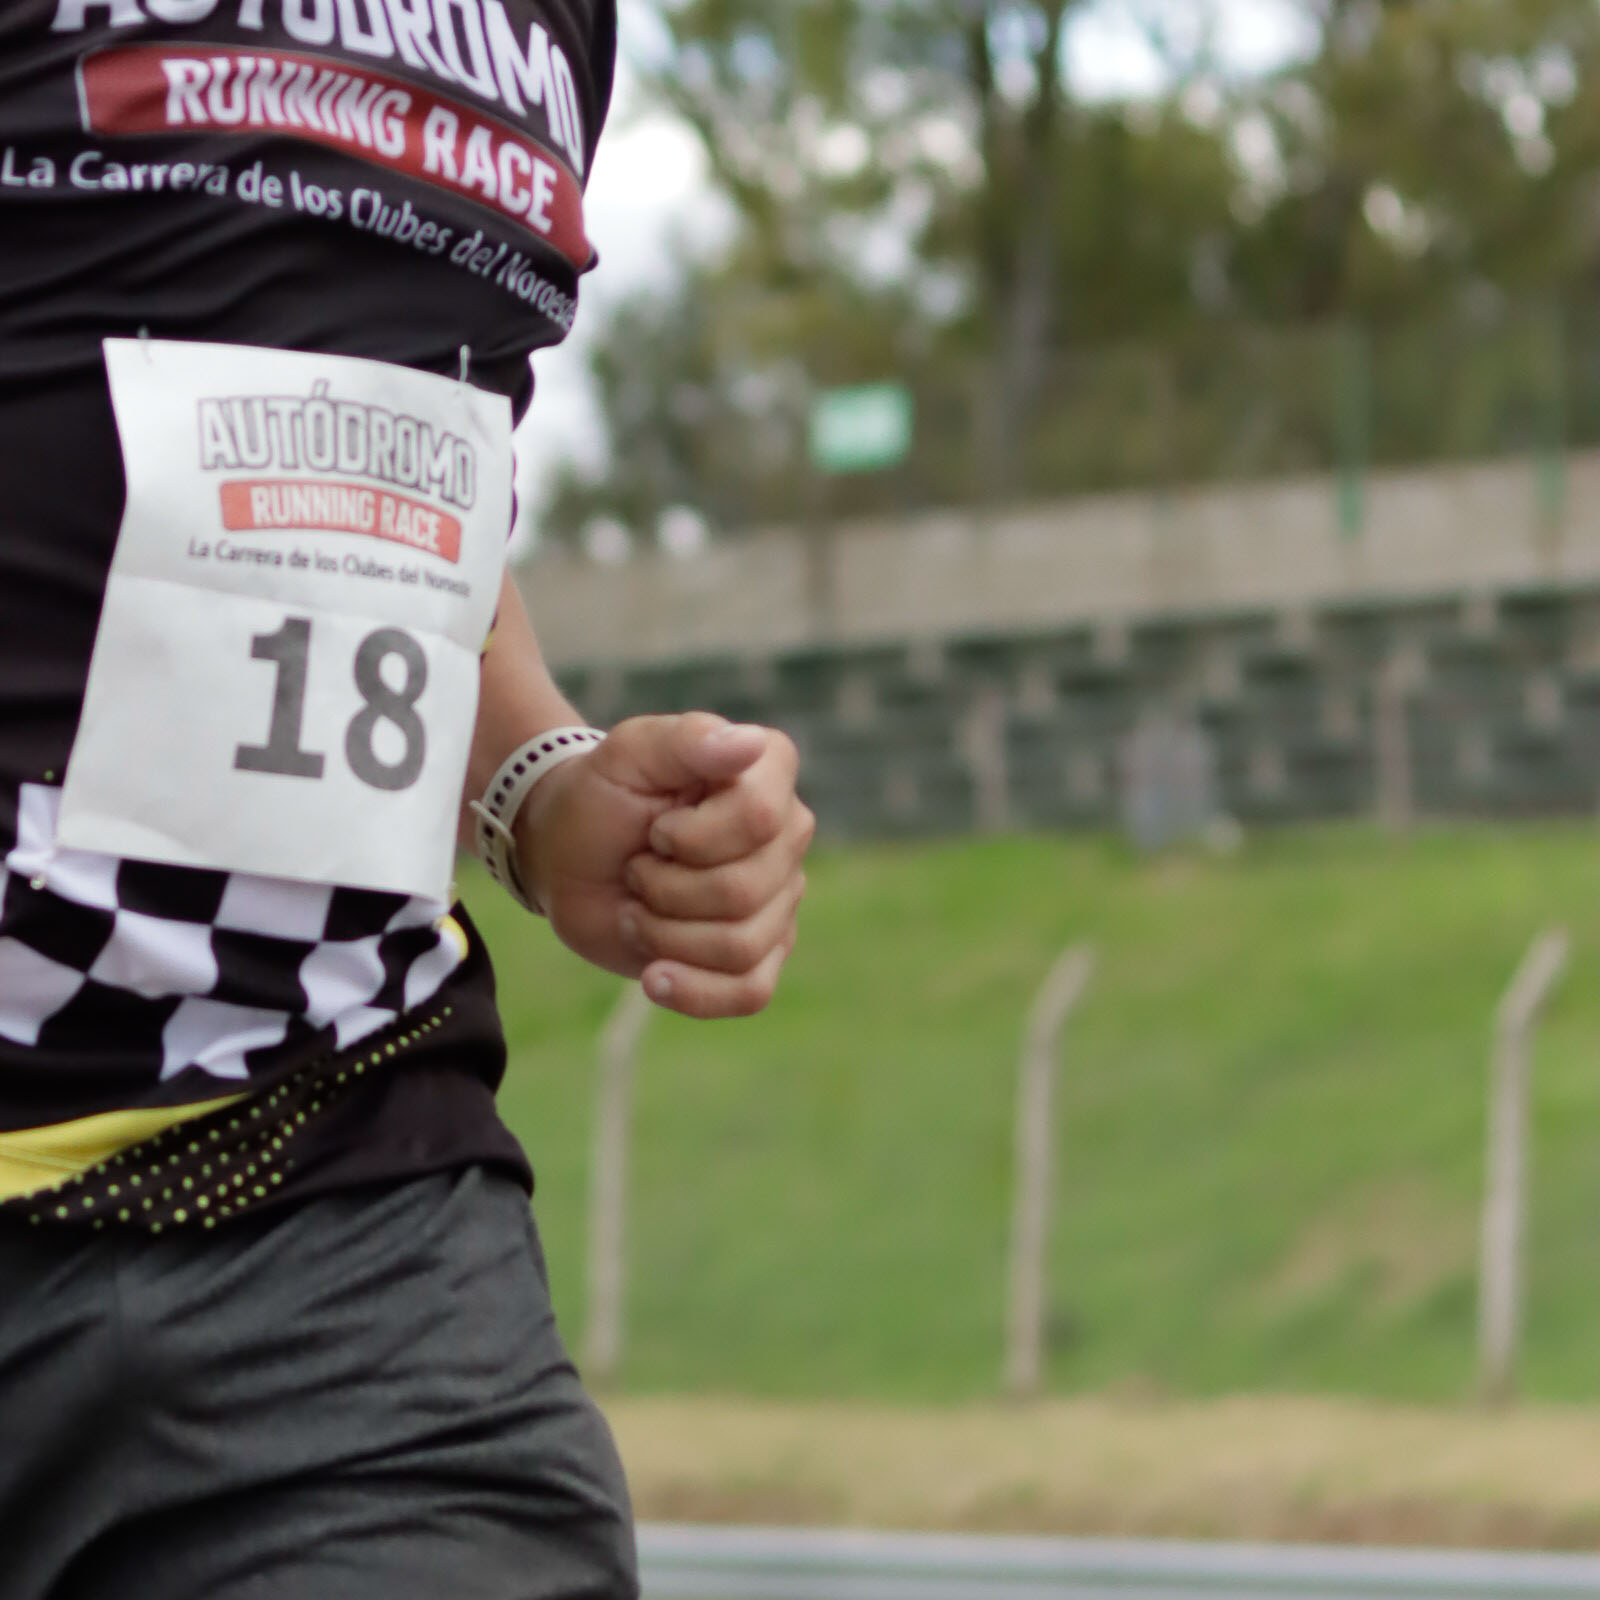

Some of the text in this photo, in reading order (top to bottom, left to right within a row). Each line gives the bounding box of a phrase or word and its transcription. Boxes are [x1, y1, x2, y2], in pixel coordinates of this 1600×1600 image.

[161, 56, 558, 235] RUNNING RACE
[1, 147, 55, 188] La
[69, 150, 229, 196] Carrera
[236, 160, 284, 208] de
[290, 169, 344, 219] los
[350, 187, 453, 255] Clubes
[450, 229, 508, 277] del
[197, 379, 476, 512] AUTÓDROMO
[188, 536, 210, 559] La
[215, 539, 283, 568] Carrera
[288, 547, 310, 569] de
[314, 549, 339, 573] los
[343, 553, 395, 581] Clubes
[398, 563, 419, 585] del
[251, 484, 442, 552] RUNNING RACE
[233, 616, 429, 792] 18
